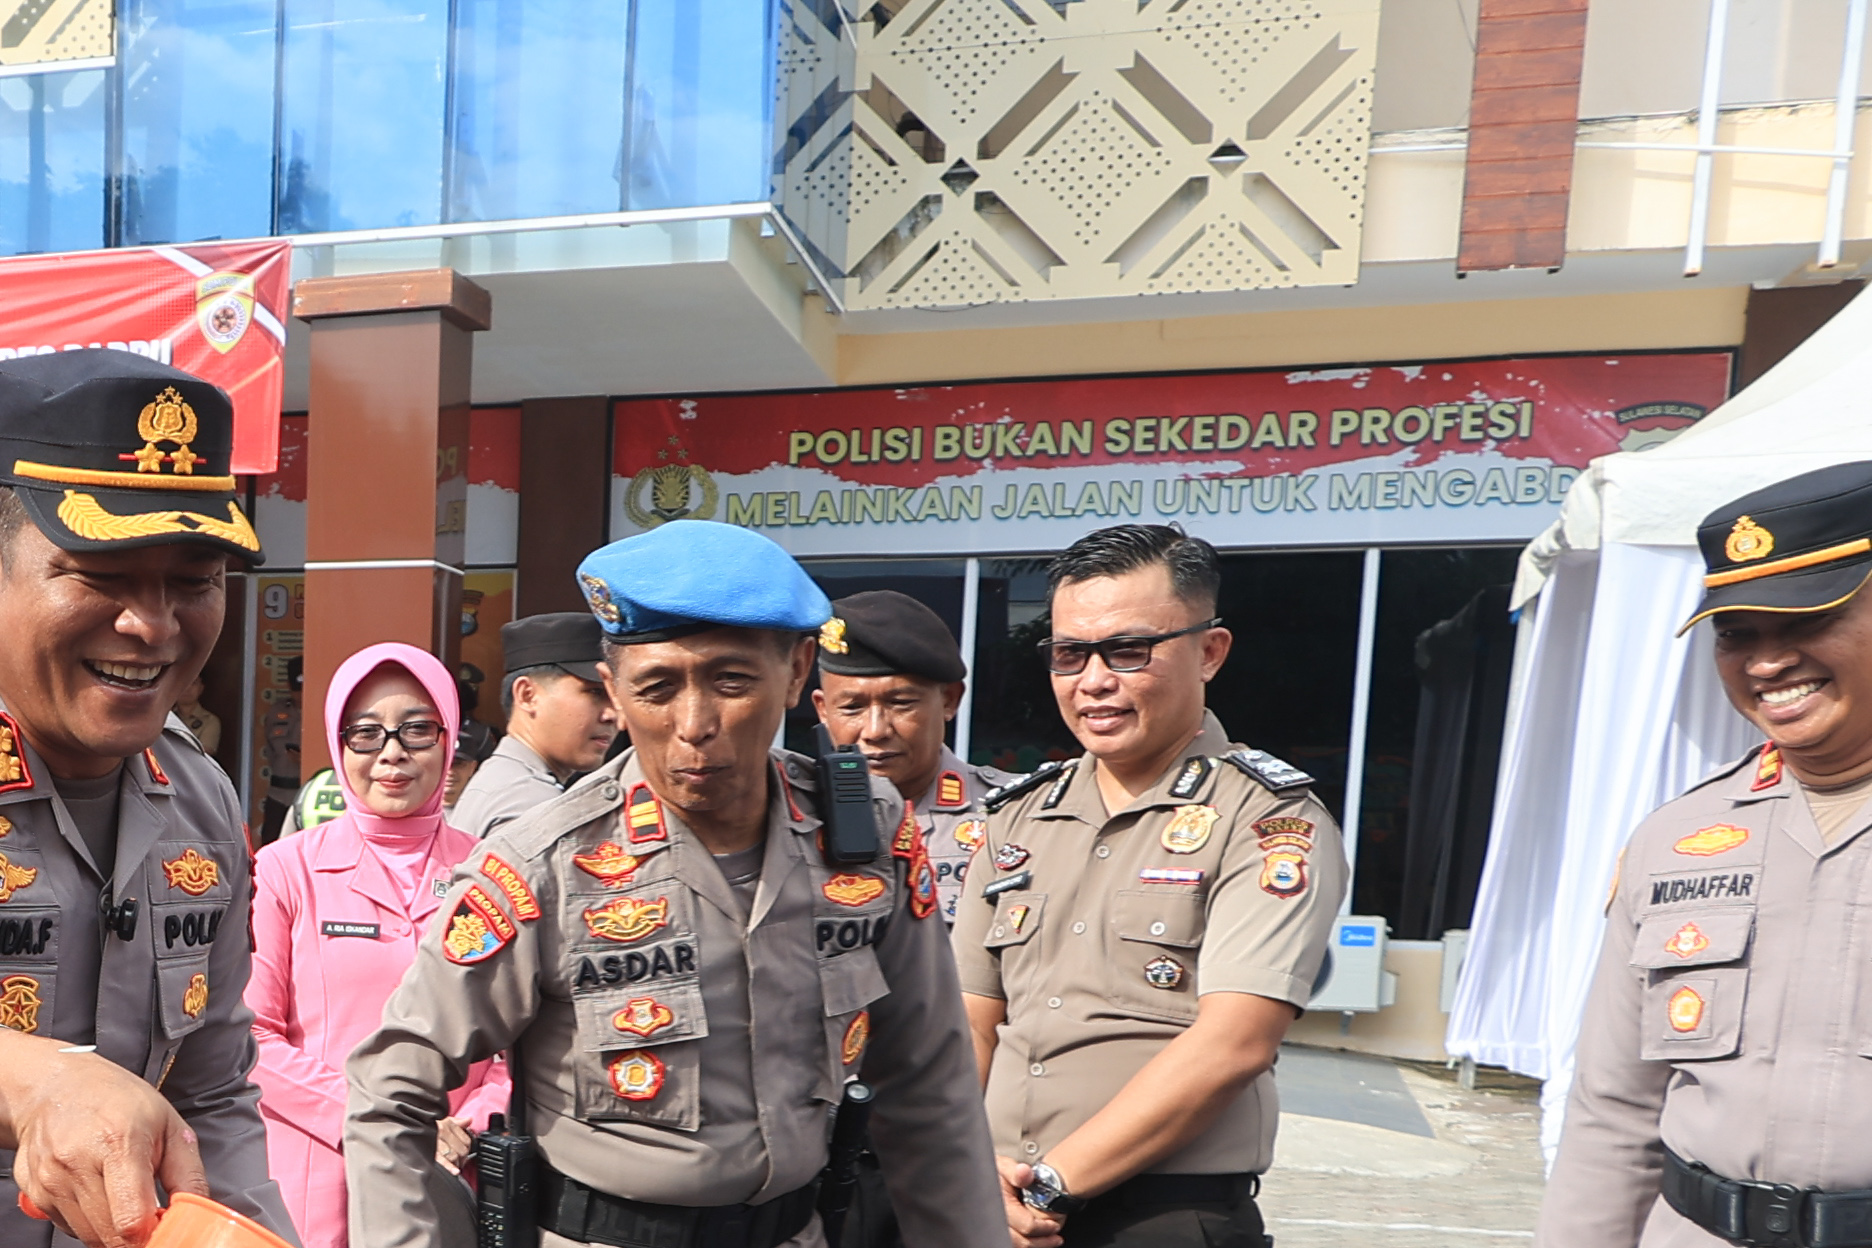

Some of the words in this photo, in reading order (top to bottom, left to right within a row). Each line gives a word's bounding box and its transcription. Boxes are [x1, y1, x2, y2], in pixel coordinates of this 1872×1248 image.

[787, 426, 922, 466] POLISI
[933, 421, 1093, 460] BUKAN
[1104, 411, 1318, 454] SEKEDAR
[1330, 402, 1532, 446] PROFESI
[727, 484, 982, 527] MELAINKAN
[991, 480, 1143, 519] JALAN
[1153, 475, 1318, 515] UNTUK
[1329, 465, 1578, 512] MENGABD
[264, 584, 288, 619] 9
[469, 889, 510, 934] PROPAM
[496, 867, 535, 915] PROPAM
[1650, 873, 1754, 905] MUDHAFFAR
[575, 943, 695, 988] ASDAR
